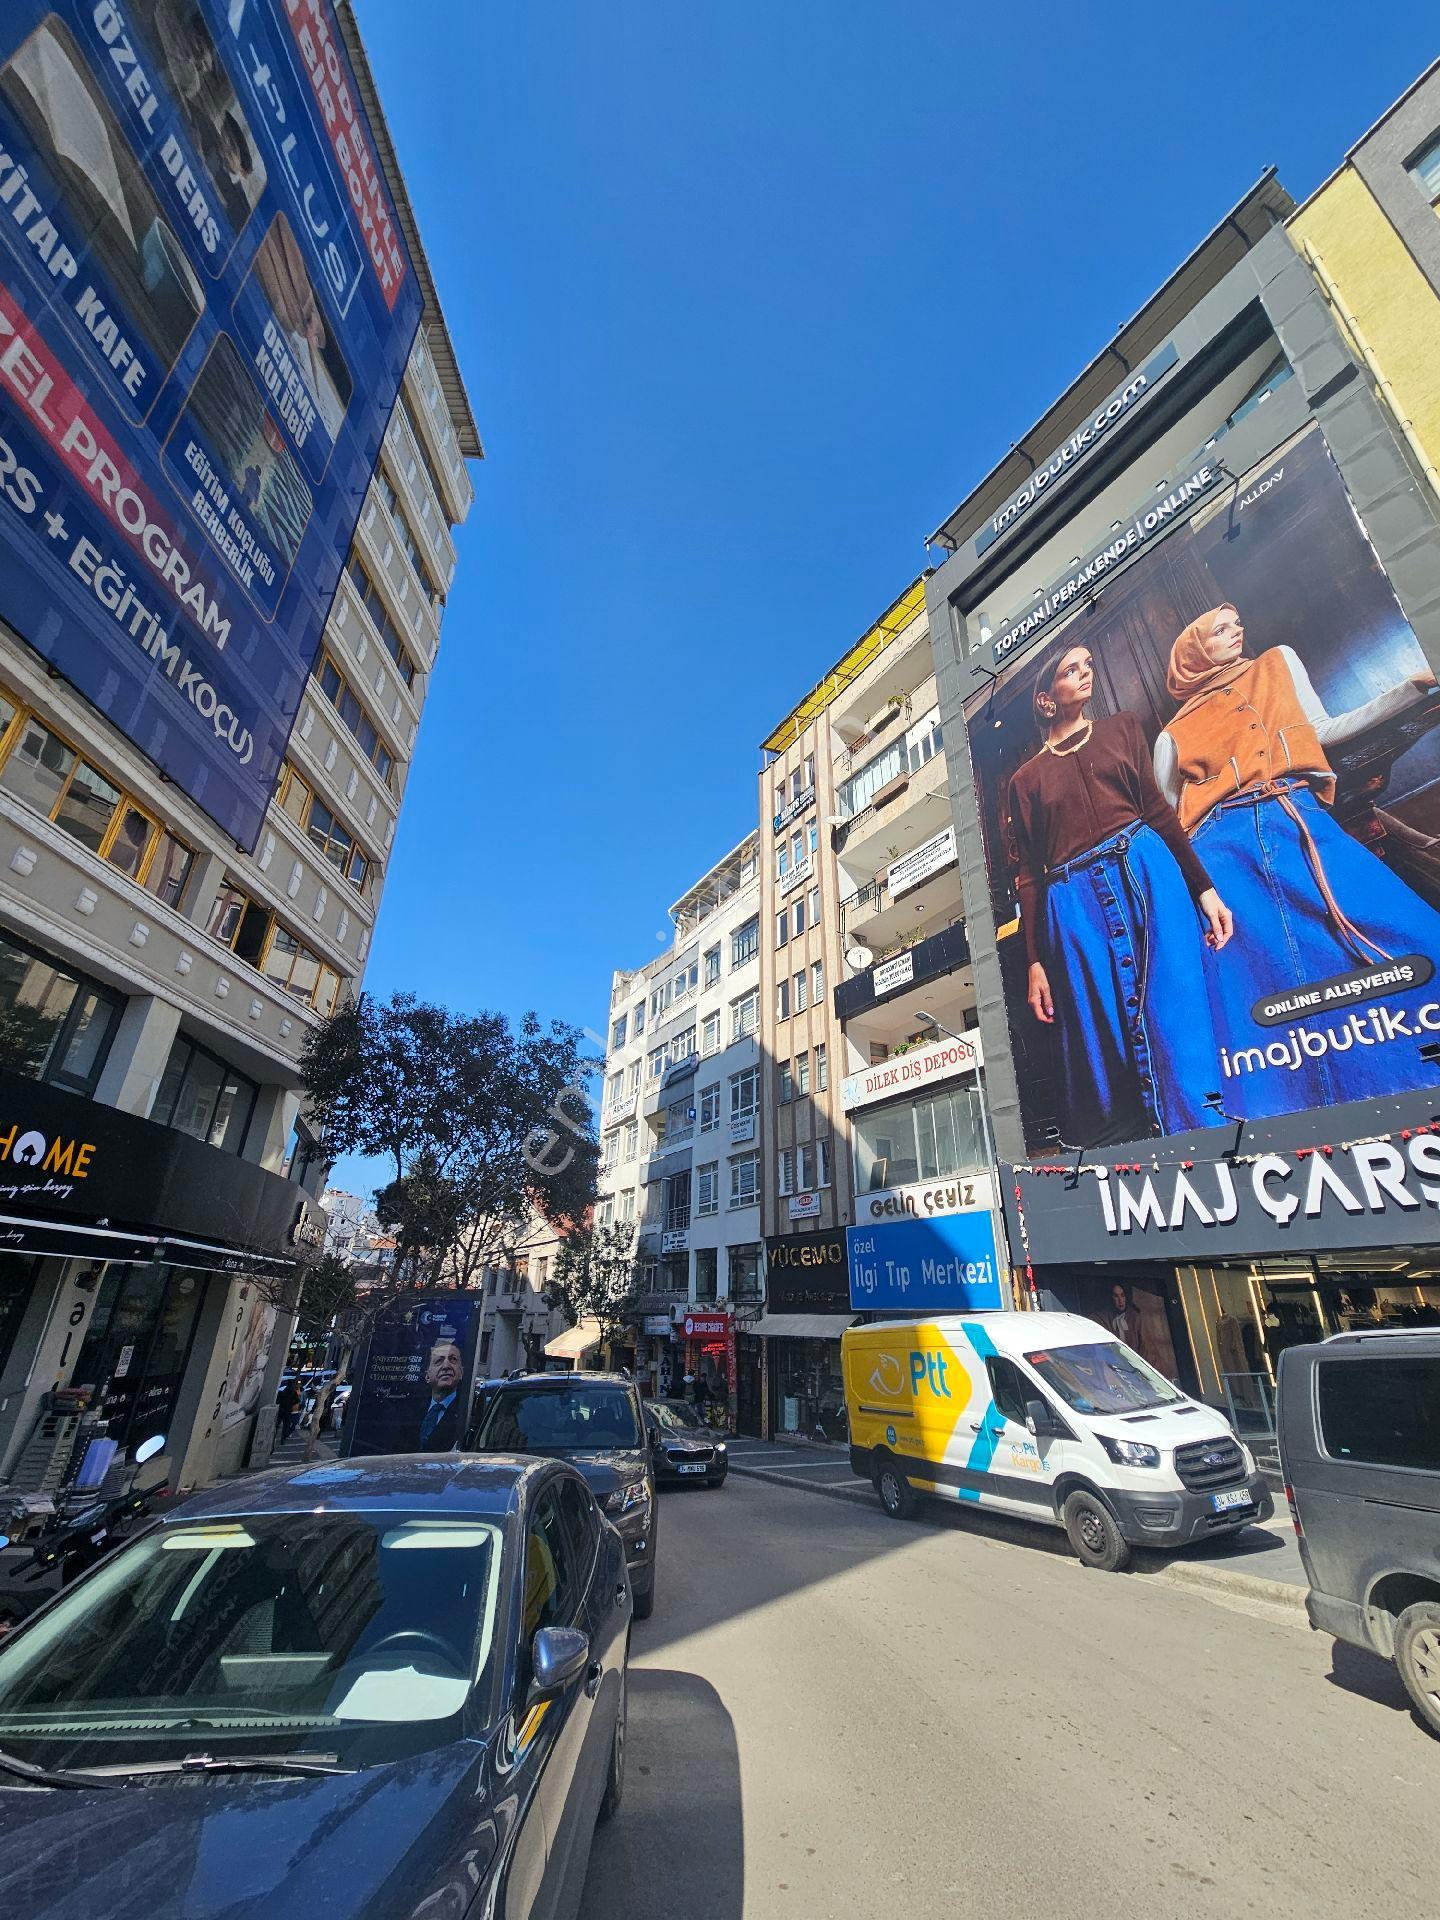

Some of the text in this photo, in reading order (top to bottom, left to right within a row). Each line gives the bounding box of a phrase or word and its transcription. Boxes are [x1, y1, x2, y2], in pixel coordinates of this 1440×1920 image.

[93, 0, 220, 253] ÖZEL DERS
[298, 23, 392, 291] BİR BOYUT
[76, 286, 147, 397] KAFE
[263, 320, 317, 431] DENEME
[255, 344, 308, 449] KULÜBÜ
[993, 374, 1149, 533] imajbutik.com
[1240, 467, 1284, 511] ALLDAY
[61, 416, 231, 651] PROGRAM
[184, 440, 276, 587] EĞİTİM KOÇLUĞU
[191, 489, 254, 588] REHBERLİK
[994, 606, 1045, 656] TOPTAN
[1051, 527, 1138, 608] PERAKENDE
[69, 534, 181, 674] EĞİTİM
[177, 660, 255, 765] KOÇU)
[1325, 964, 1414, 1002] ALIŞVERİŞ
[866, 1072, 900, 1094] DİLEK
[902, 1059, 922, 1081] DİŞ
[854, 1238, 875, 1254] özel
[1096, 1164, 1239, 1232] İMAJ
[854, 1254, 993, 1294] İlgi Tıp Merkezi
[909, 1351, 952, 1399] Ptt
